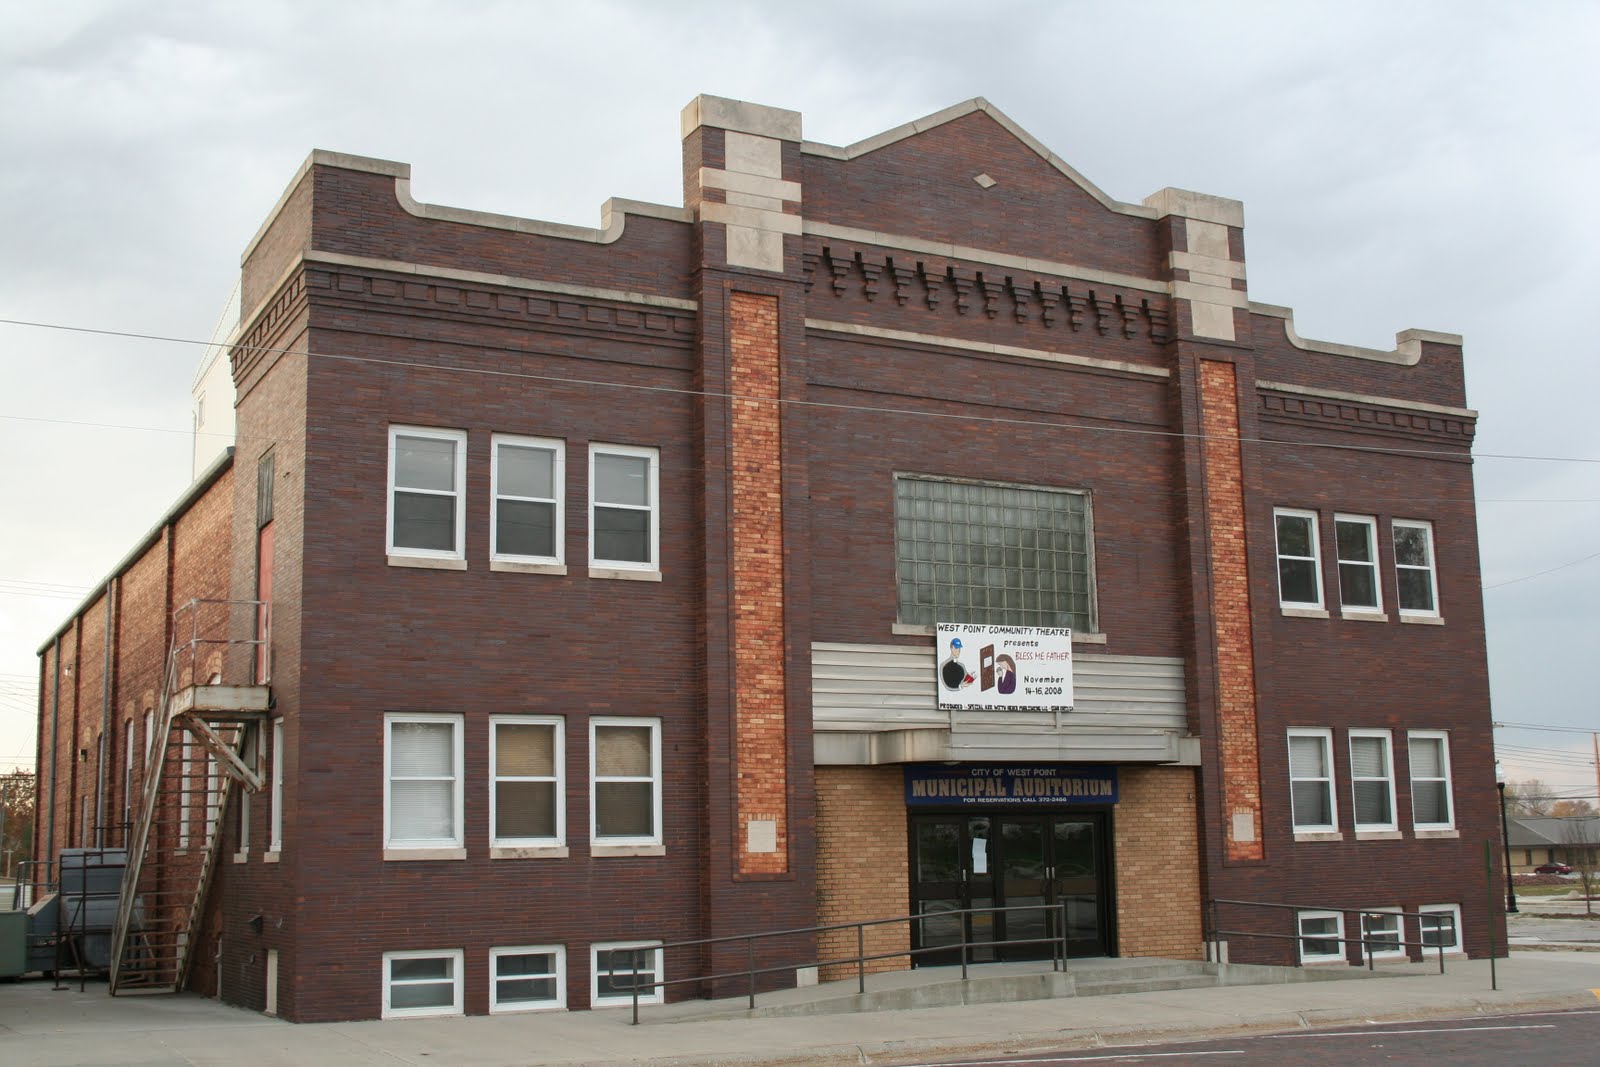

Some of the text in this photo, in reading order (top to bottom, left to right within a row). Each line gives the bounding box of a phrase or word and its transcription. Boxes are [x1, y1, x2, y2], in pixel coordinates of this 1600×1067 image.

[938, 624, 1070, 637] WEST POINT COMMUNITY THEATRE
[1015, 652, 1070, 660] BLESS ME FATHER
[912, 778, 1113, 797] MUNICIPAL AUDITORIUM
